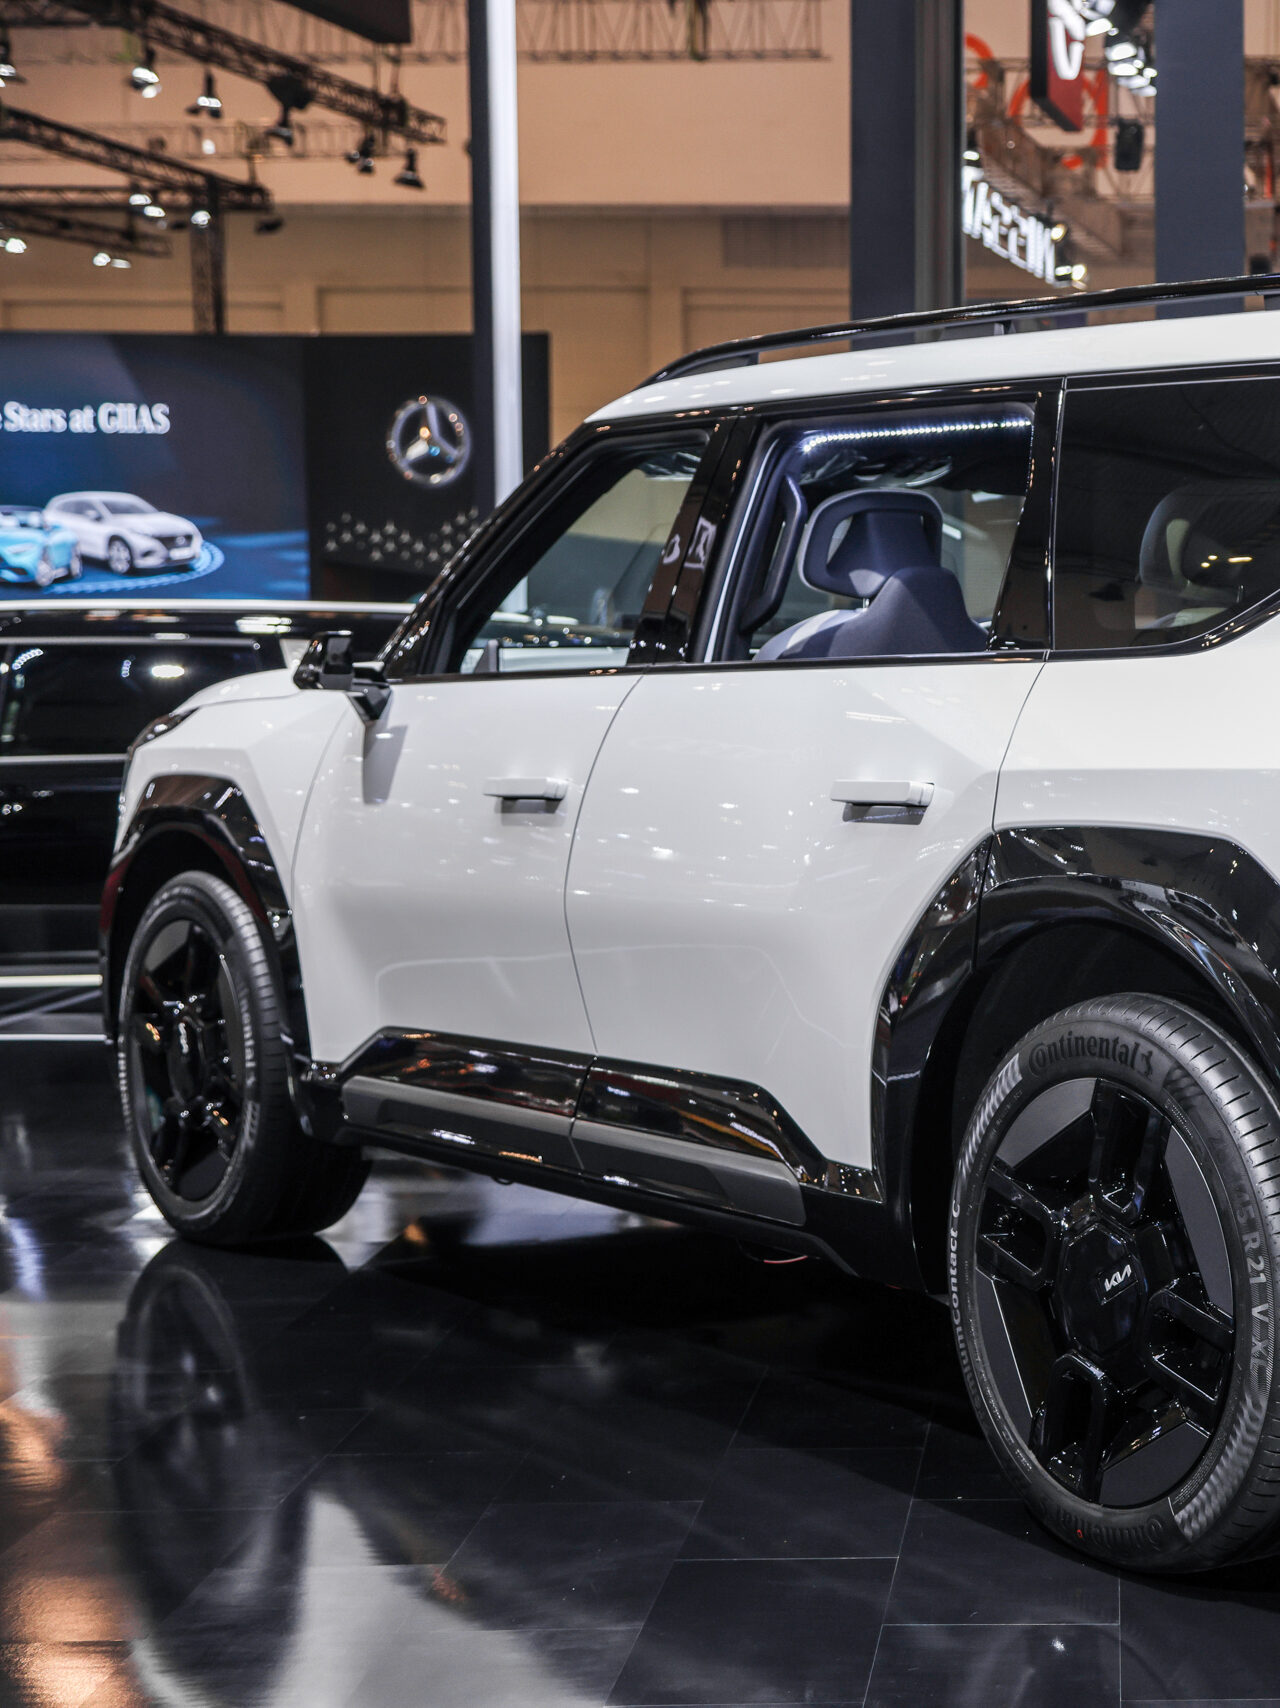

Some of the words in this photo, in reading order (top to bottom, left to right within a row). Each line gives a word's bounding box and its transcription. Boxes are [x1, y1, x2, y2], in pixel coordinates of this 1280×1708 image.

[4, 401, 67, 433] Stars
[69, 405, 97, 433] at
[98, 402, 170, 434] GIIAS
[1028, 1030, 1141, 1079] Continental
